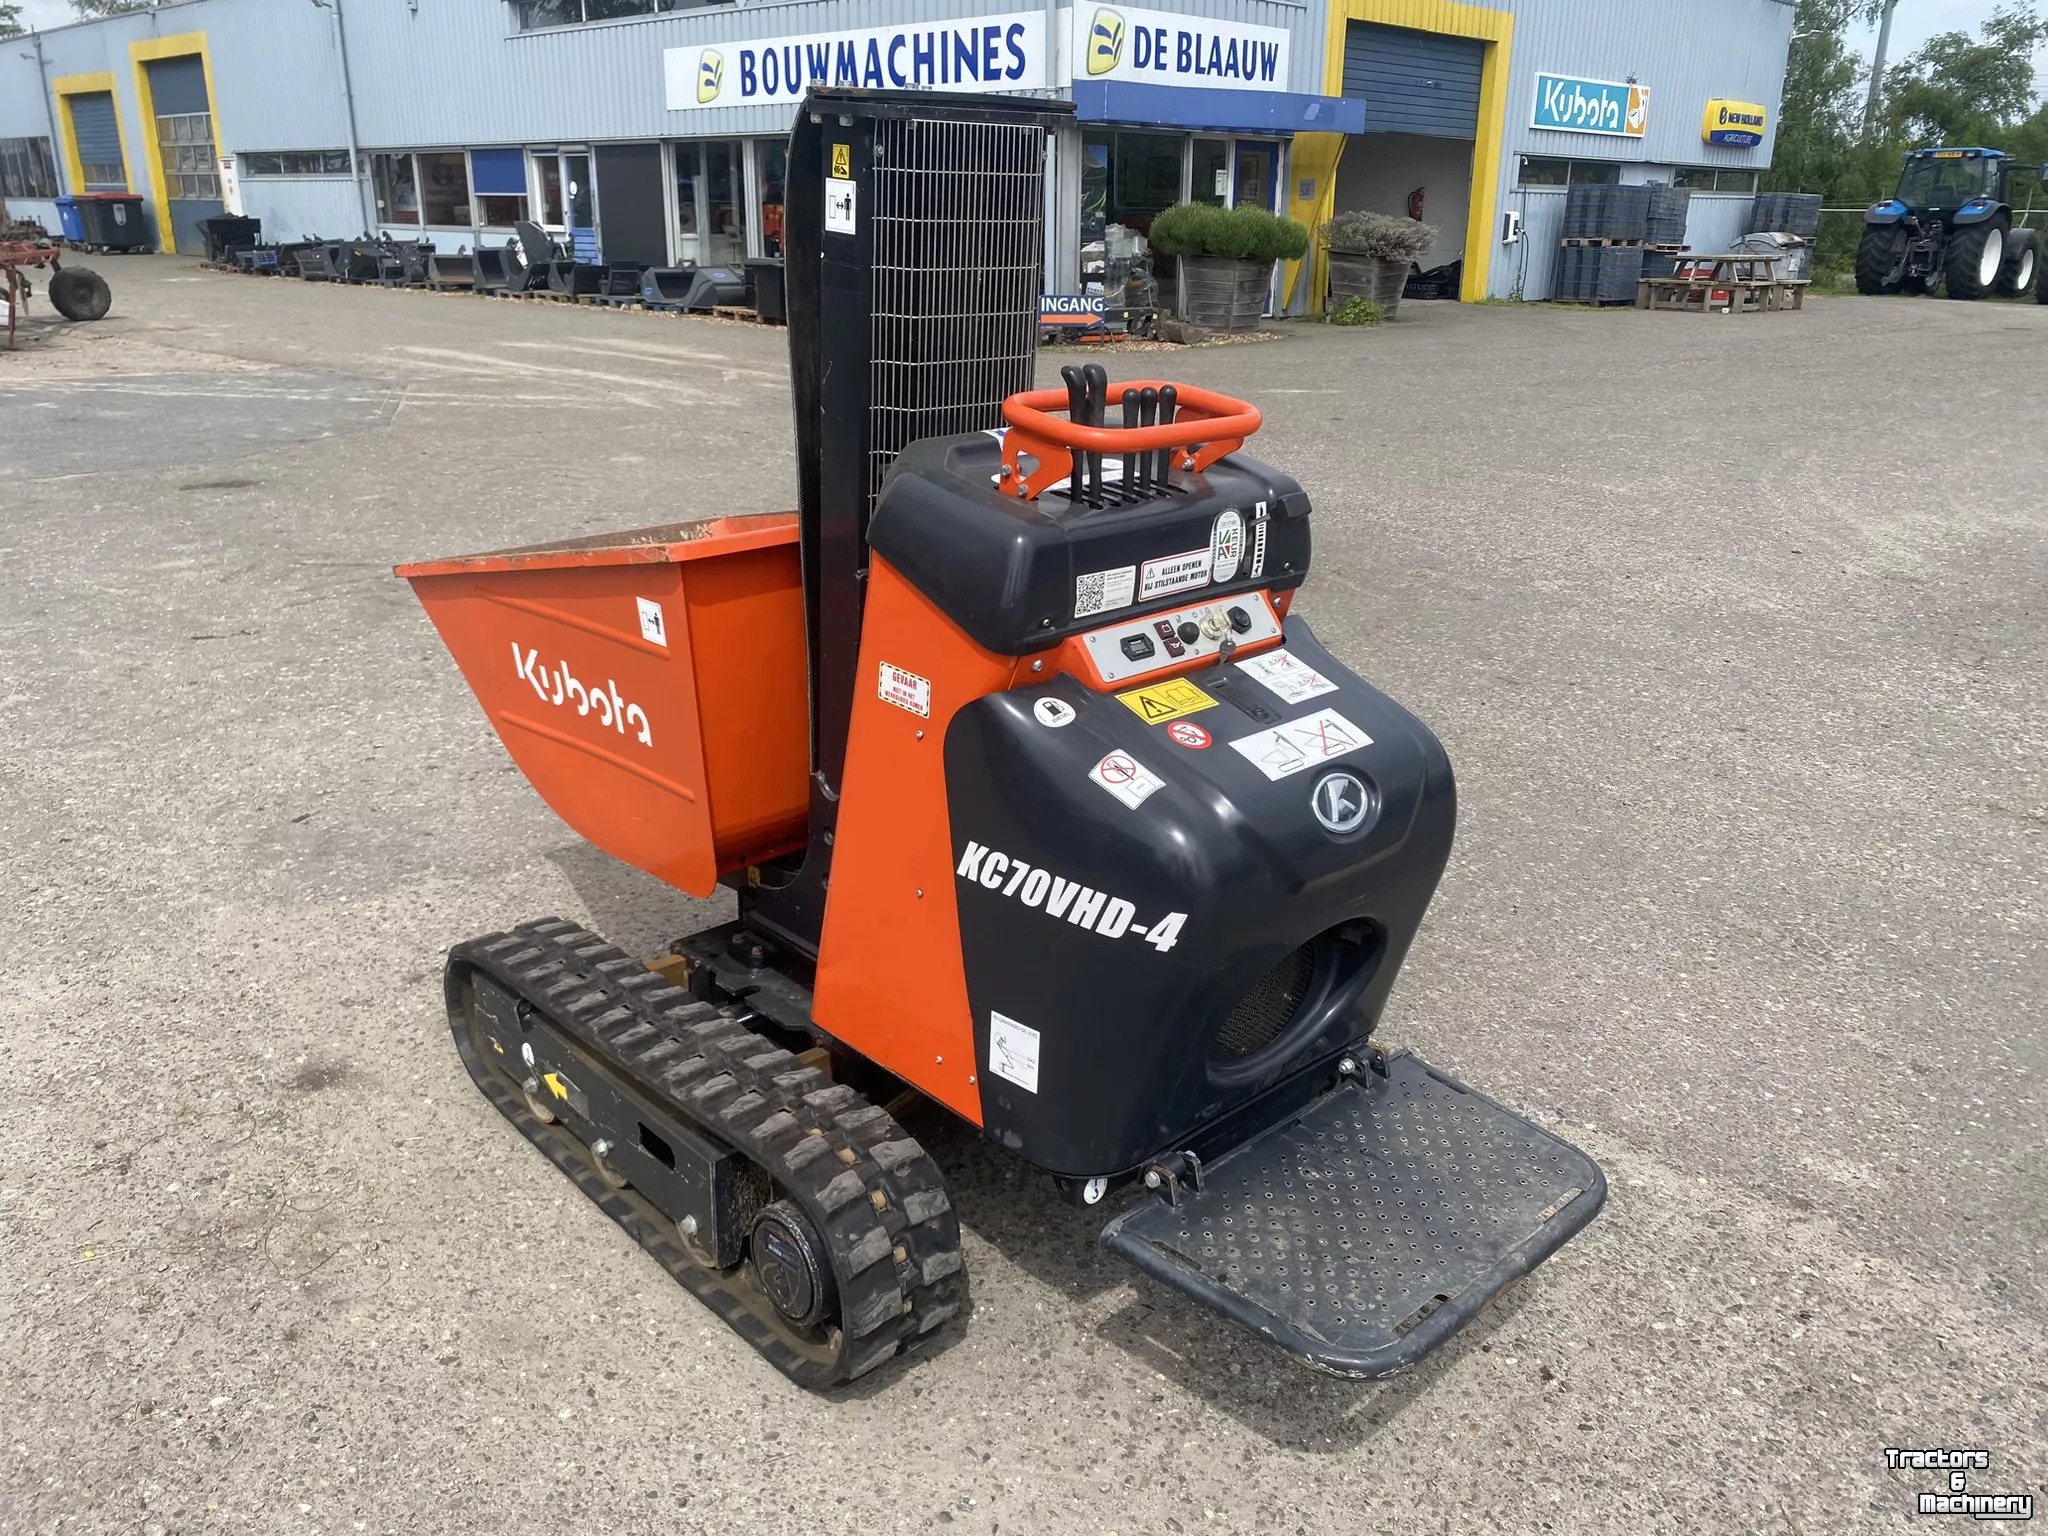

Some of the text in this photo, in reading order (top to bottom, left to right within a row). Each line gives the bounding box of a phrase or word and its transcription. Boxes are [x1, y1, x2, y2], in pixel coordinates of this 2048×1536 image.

[740, 23, 1026, 97] BOUWMACHINES
[1133, 25, 1279, 82] DE BLAAUW
[1544, 79, 1619, 129] Kubota
[1041, 297, 1104, 312] INGANG
[1144, 582, 1154, 592] BIJ
[1154, 574, 1189, 590] STILSTAANDE
[1190, 569, 1208, 580] MOTOR
[1161, 564, 1181, 576] ALLEEN
[1182, 560, 1203, 572] OPENEN
[511, 641, 653, 748] Kubota
[893, 672, 917, 690] GEVAAR
[956, 840, 1189, 953] KC70VHD-4
